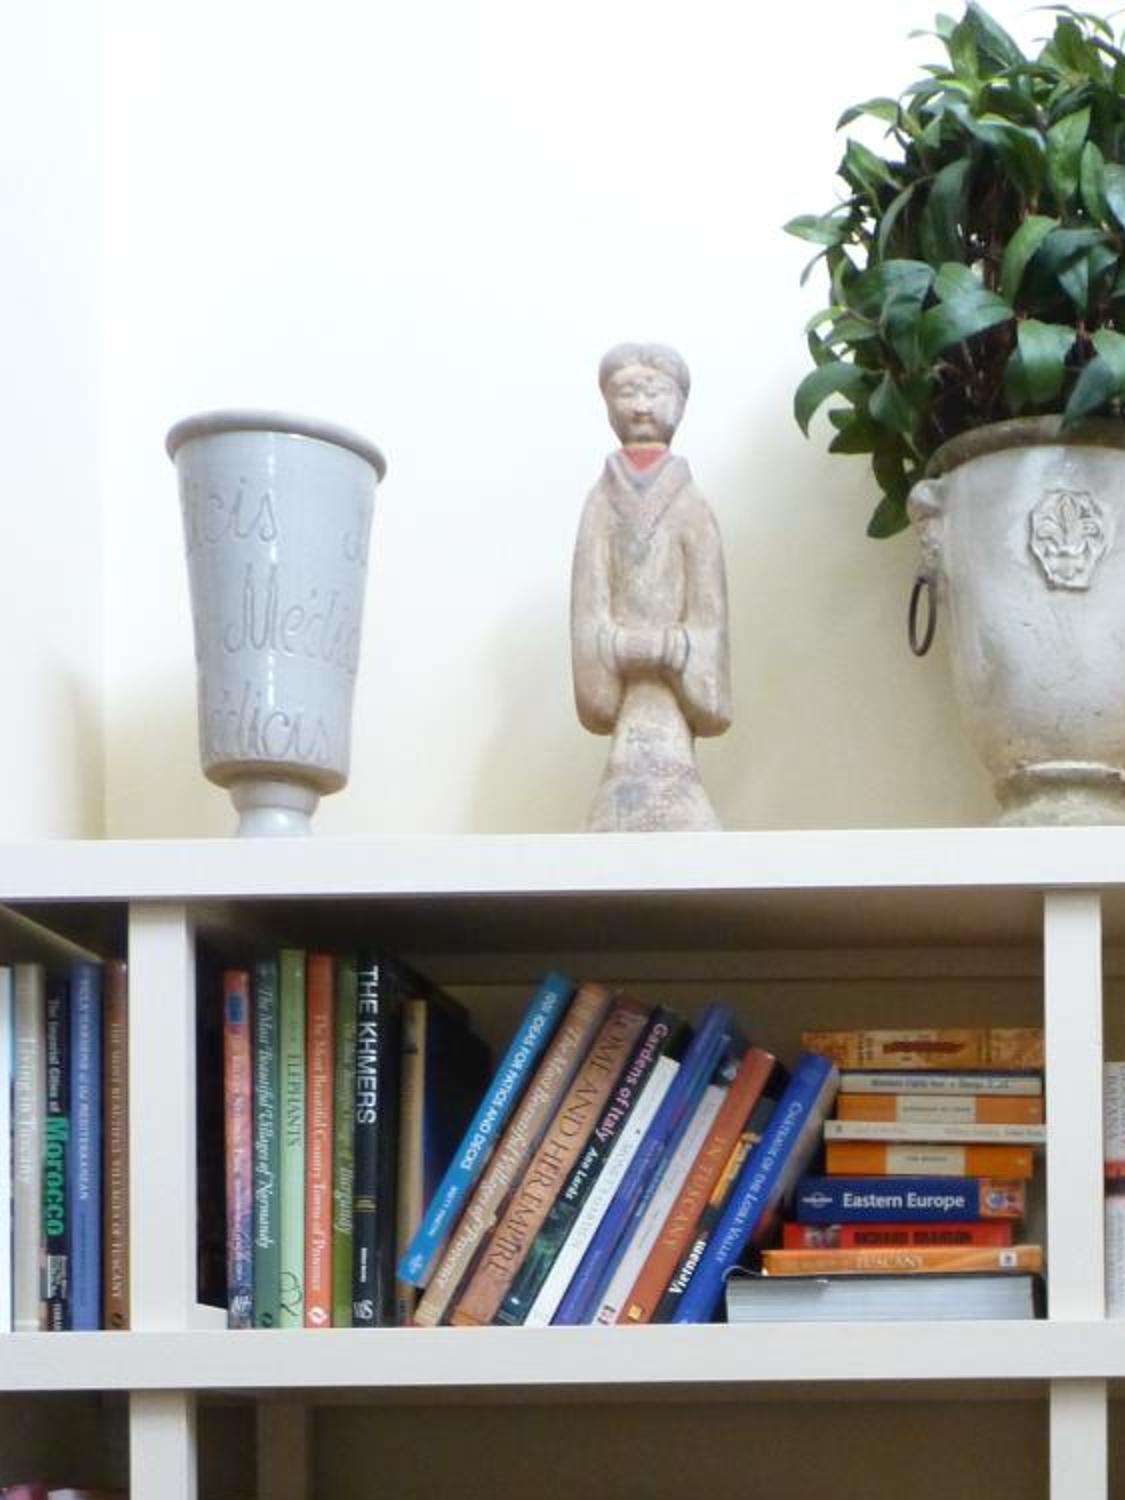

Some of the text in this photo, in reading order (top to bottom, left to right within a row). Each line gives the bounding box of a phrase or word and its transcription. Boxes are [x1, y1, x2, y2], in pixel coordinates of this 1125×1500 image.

[357, 966, 378, 1123] THE KHMERS
[624, 1019, 670, 1087] Gardens
[553, 1078, 602, 1140] AND
[591, 1103, 626, 1145] Italy
[613, 1086, 635, 1109] of
[45, 1116, 69, 1237] Morocco
[527, 1137, 571, 1191] HER
[483, 1188, 545, 1276] EMPIRE
[843, 1193, 965, 1213] Eastern Europe
[667, 1237, 707, 1296] Vietnam
